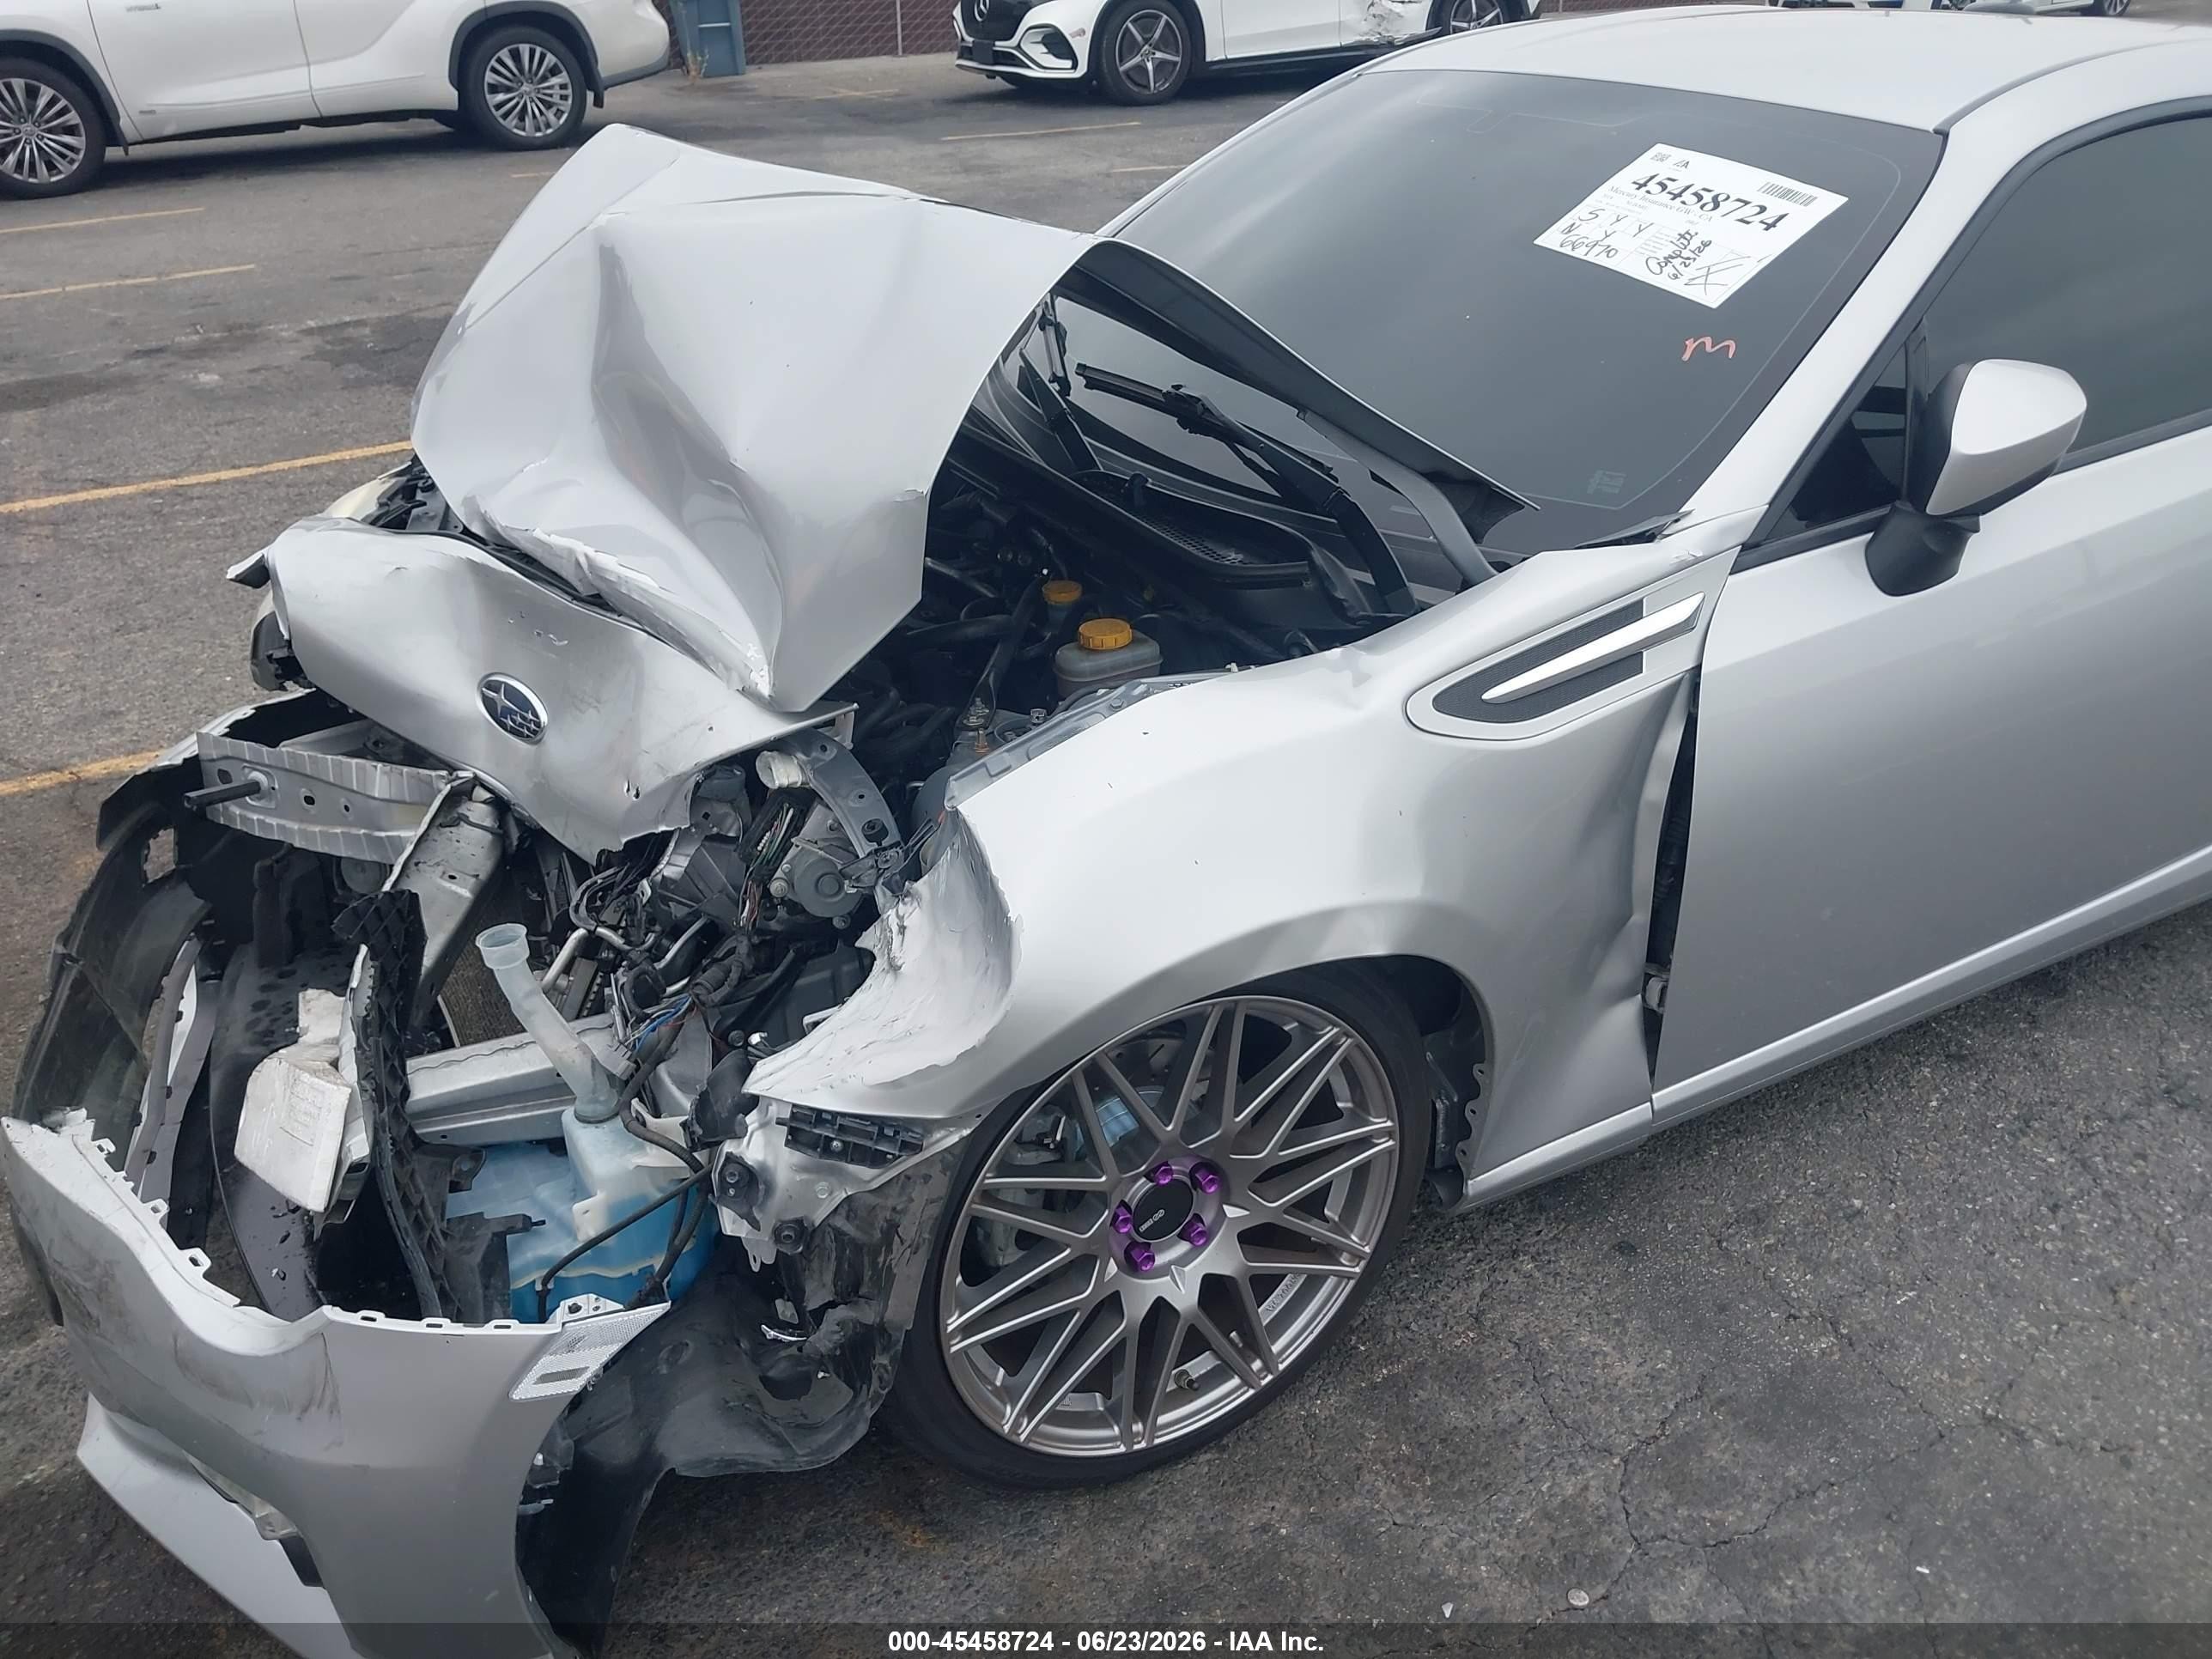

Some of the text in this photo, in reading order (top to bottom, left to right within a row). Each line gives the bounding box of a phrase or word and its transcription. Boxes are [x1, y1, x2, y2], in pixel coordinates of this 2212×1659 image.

[1608, 185, 1638, 200] Mercury
[1639, 195, 1676, 210] Insurance
[1632, 173, 1790, 232] 45458724
[1560, 222, 1617, 243] N Y
[1610, 215, 1629, 226] Y
[1632, 222, 1655, 238] Y
[1559, 234, 1620, 259] 66970
